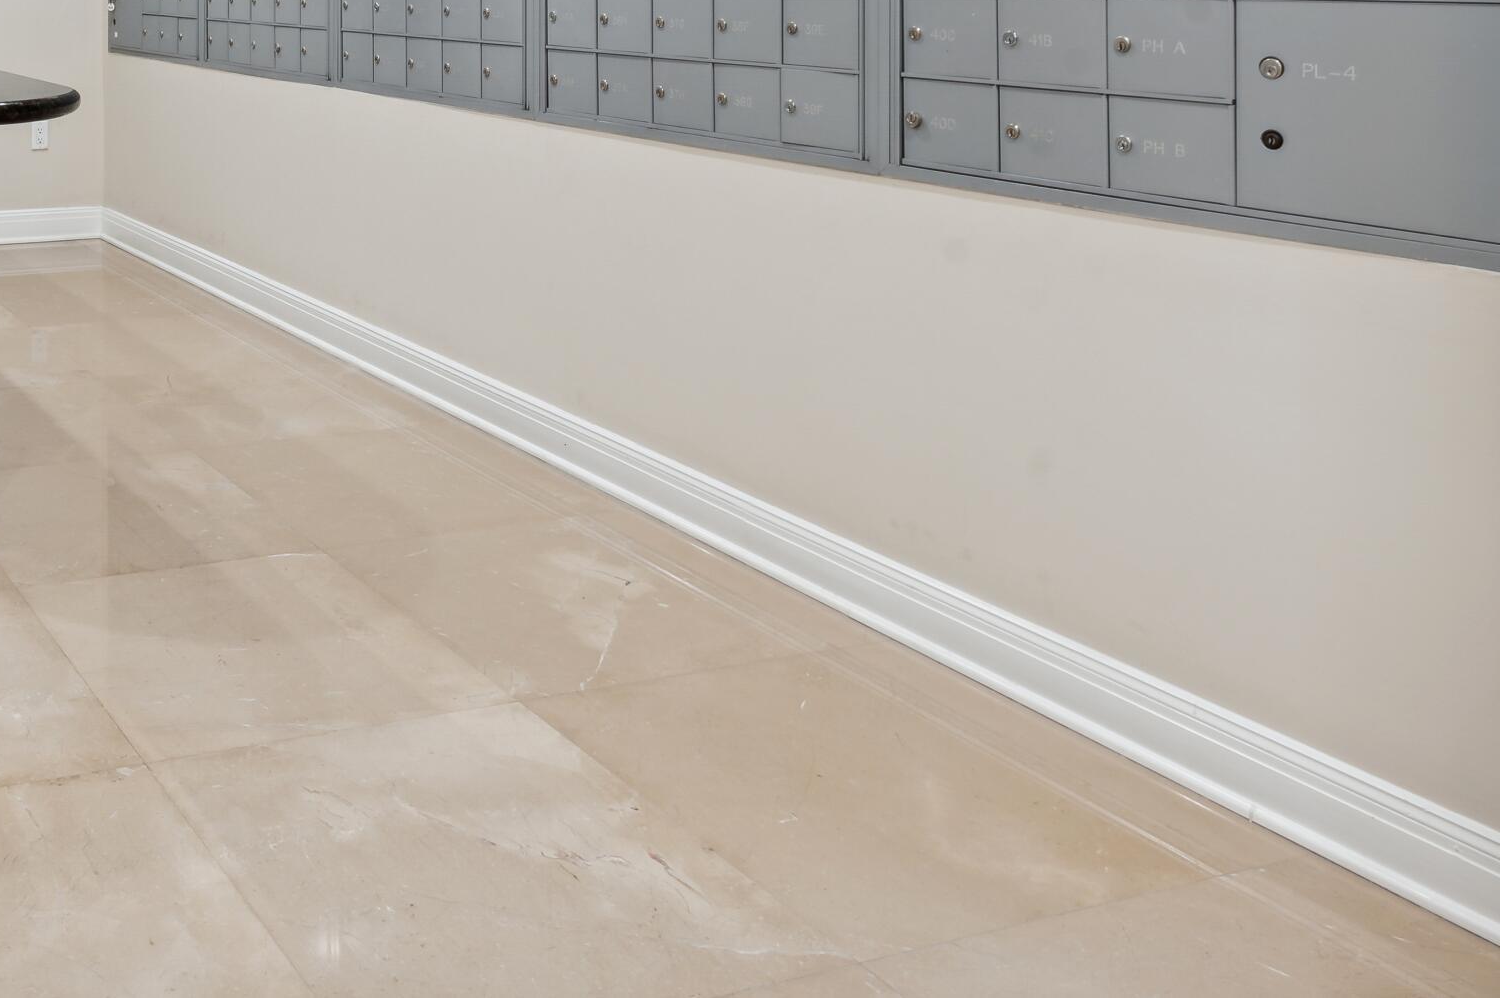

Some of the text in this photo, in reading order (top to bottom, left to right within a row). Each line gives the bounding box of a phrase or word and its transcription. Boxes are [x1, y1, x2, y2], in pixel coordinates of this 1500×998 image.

[1028, 33, 1053, 48] 41B
[1142, 38, 1186, 55] PH A
[1301, 63, 1357, 81] PL-4
[1142, 140, 1186, 158] PH B
